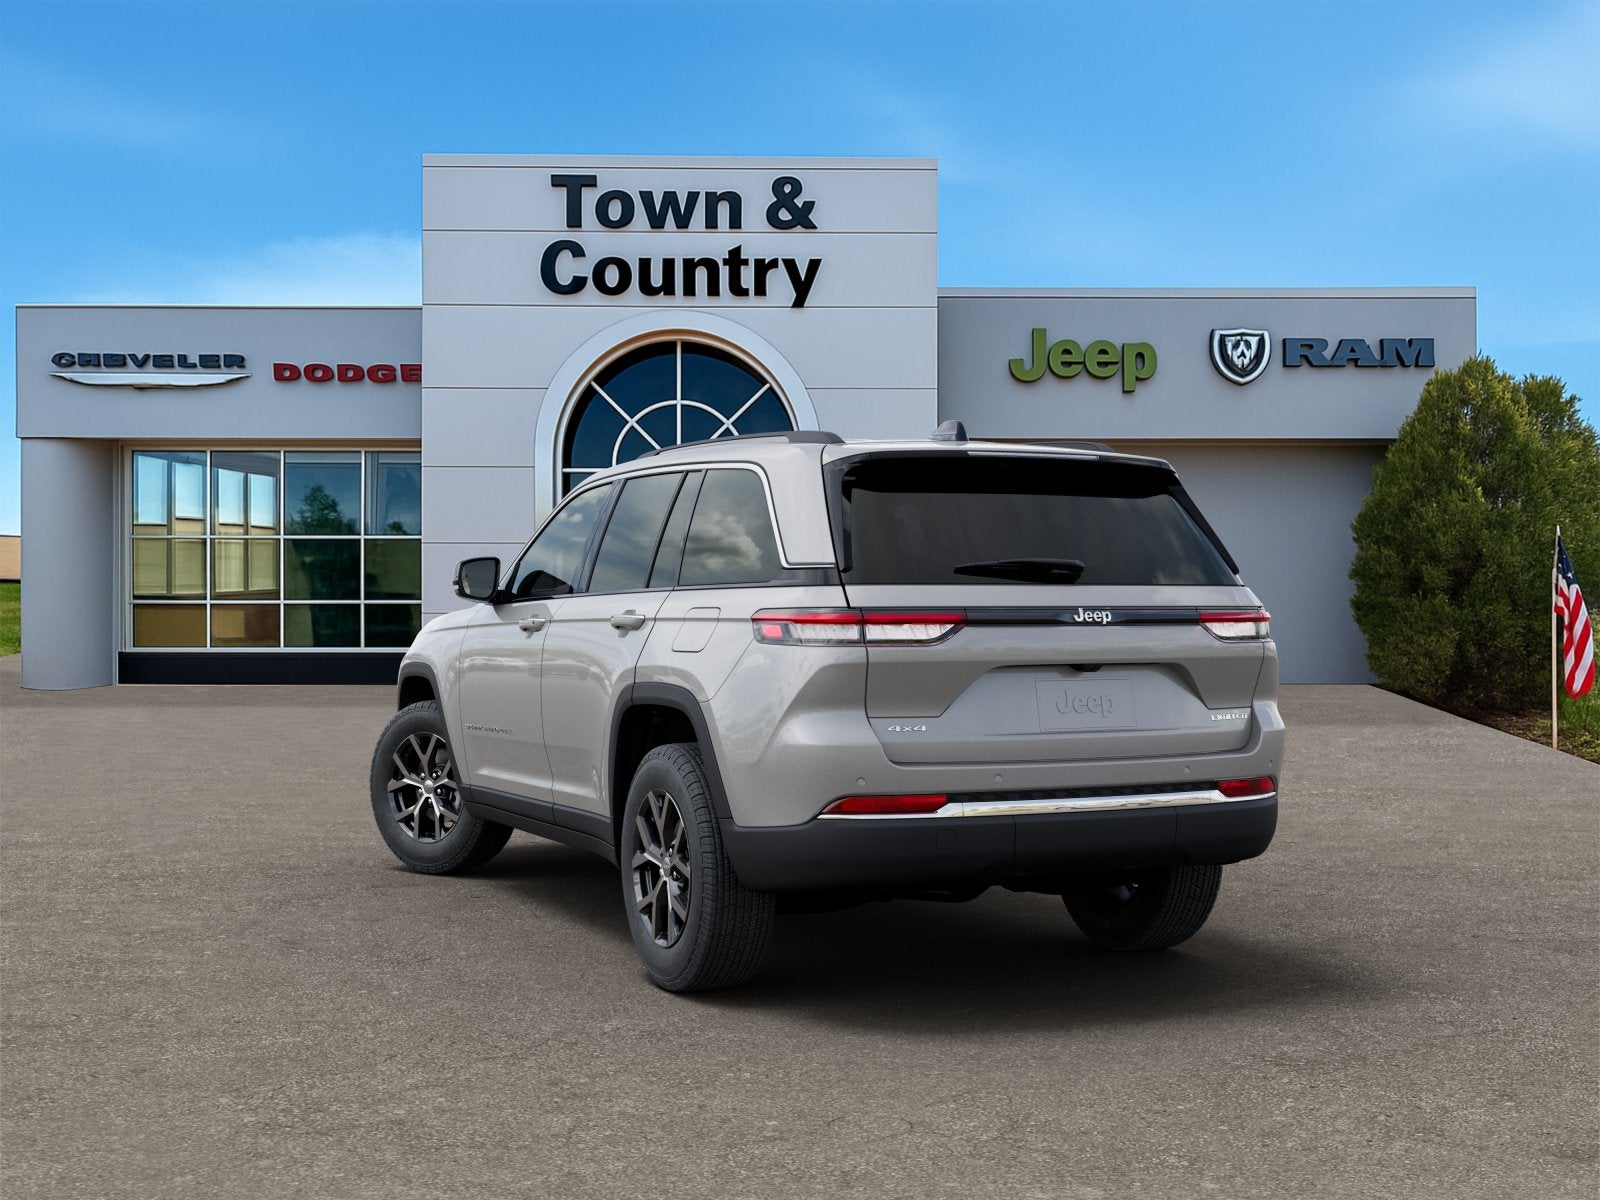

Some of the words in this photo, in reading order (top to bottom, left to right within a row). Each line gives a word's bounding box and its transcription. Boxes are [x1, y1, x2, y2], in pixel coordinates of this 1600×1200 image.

[551, 174, 743, 229] Town
[765, 175, 818, 230] &
[540, 239, 823, 308] Country
[1009, 327, 1158, 394] Jeep
[1282, 337, 1436, 368] RAM
[273, 362, 423, 384] DODGE
[1073, 607, 1112, 625] Jeep
[1055, 688, 1116, 719] Jeep
